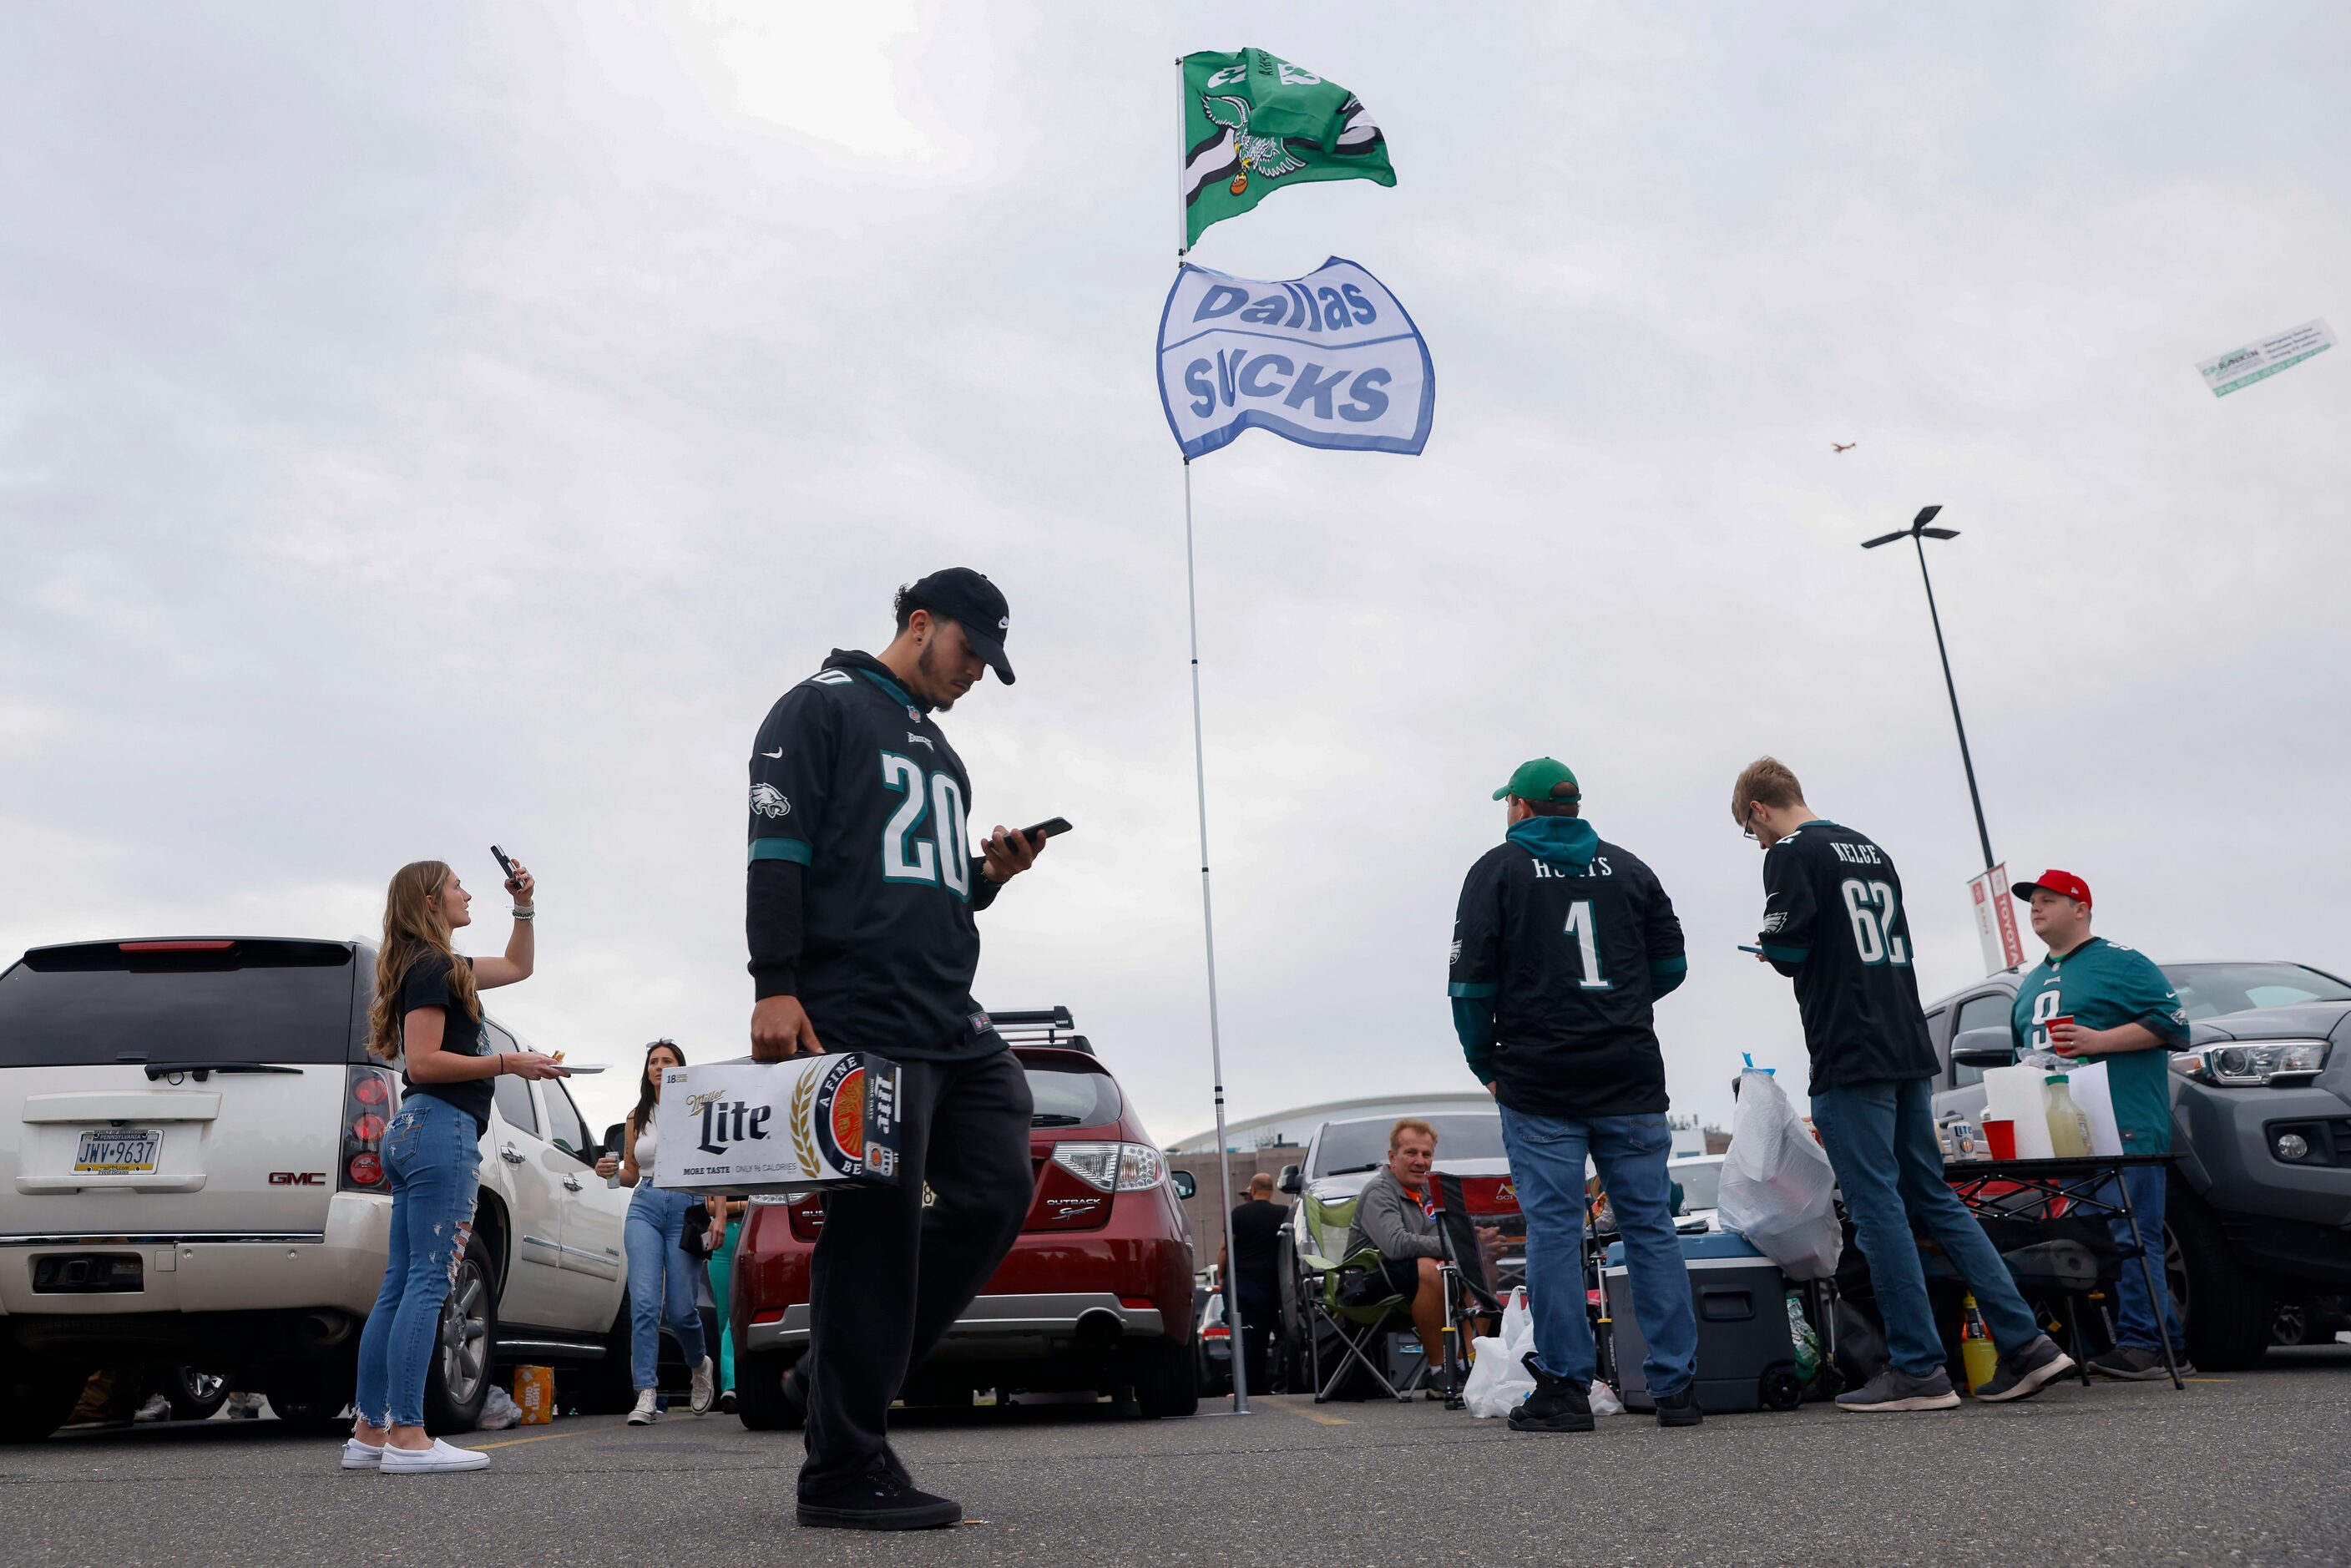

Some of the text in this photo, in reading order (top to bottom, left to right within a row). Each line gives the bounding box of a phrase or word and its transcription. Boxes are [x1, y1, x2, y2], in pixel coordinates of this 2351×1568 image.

[1192, 282, 1378, 332] Dallas
[1184, 348, 1393, 423] SUCKS
[879, 749, 972, 903] 20
[1829, 842, 1882, 864] KELCE
[1562, 898, 1615, 991] 1
[1840, 877, 1912, 967] 62
[1999, 895, 2020, 965] TOYOTA
[665, 1074, 677, 1084] 18
[685, 1089, 726, 1116] Miller
[819, 1055, 858, 1108] A FINE
[697, 1100, 771, 1156] Lite
[268, 1171, 326, 1186] GMC
[683, 1167, 705, 1176] MORE
[706, 1166, 731, 1175] TASTE
[735, 1165, 752, 1173] ONLY
[763, 1162, 796, 1172] CALORIES
[1051, 1206, 1095, 1221] Sport
